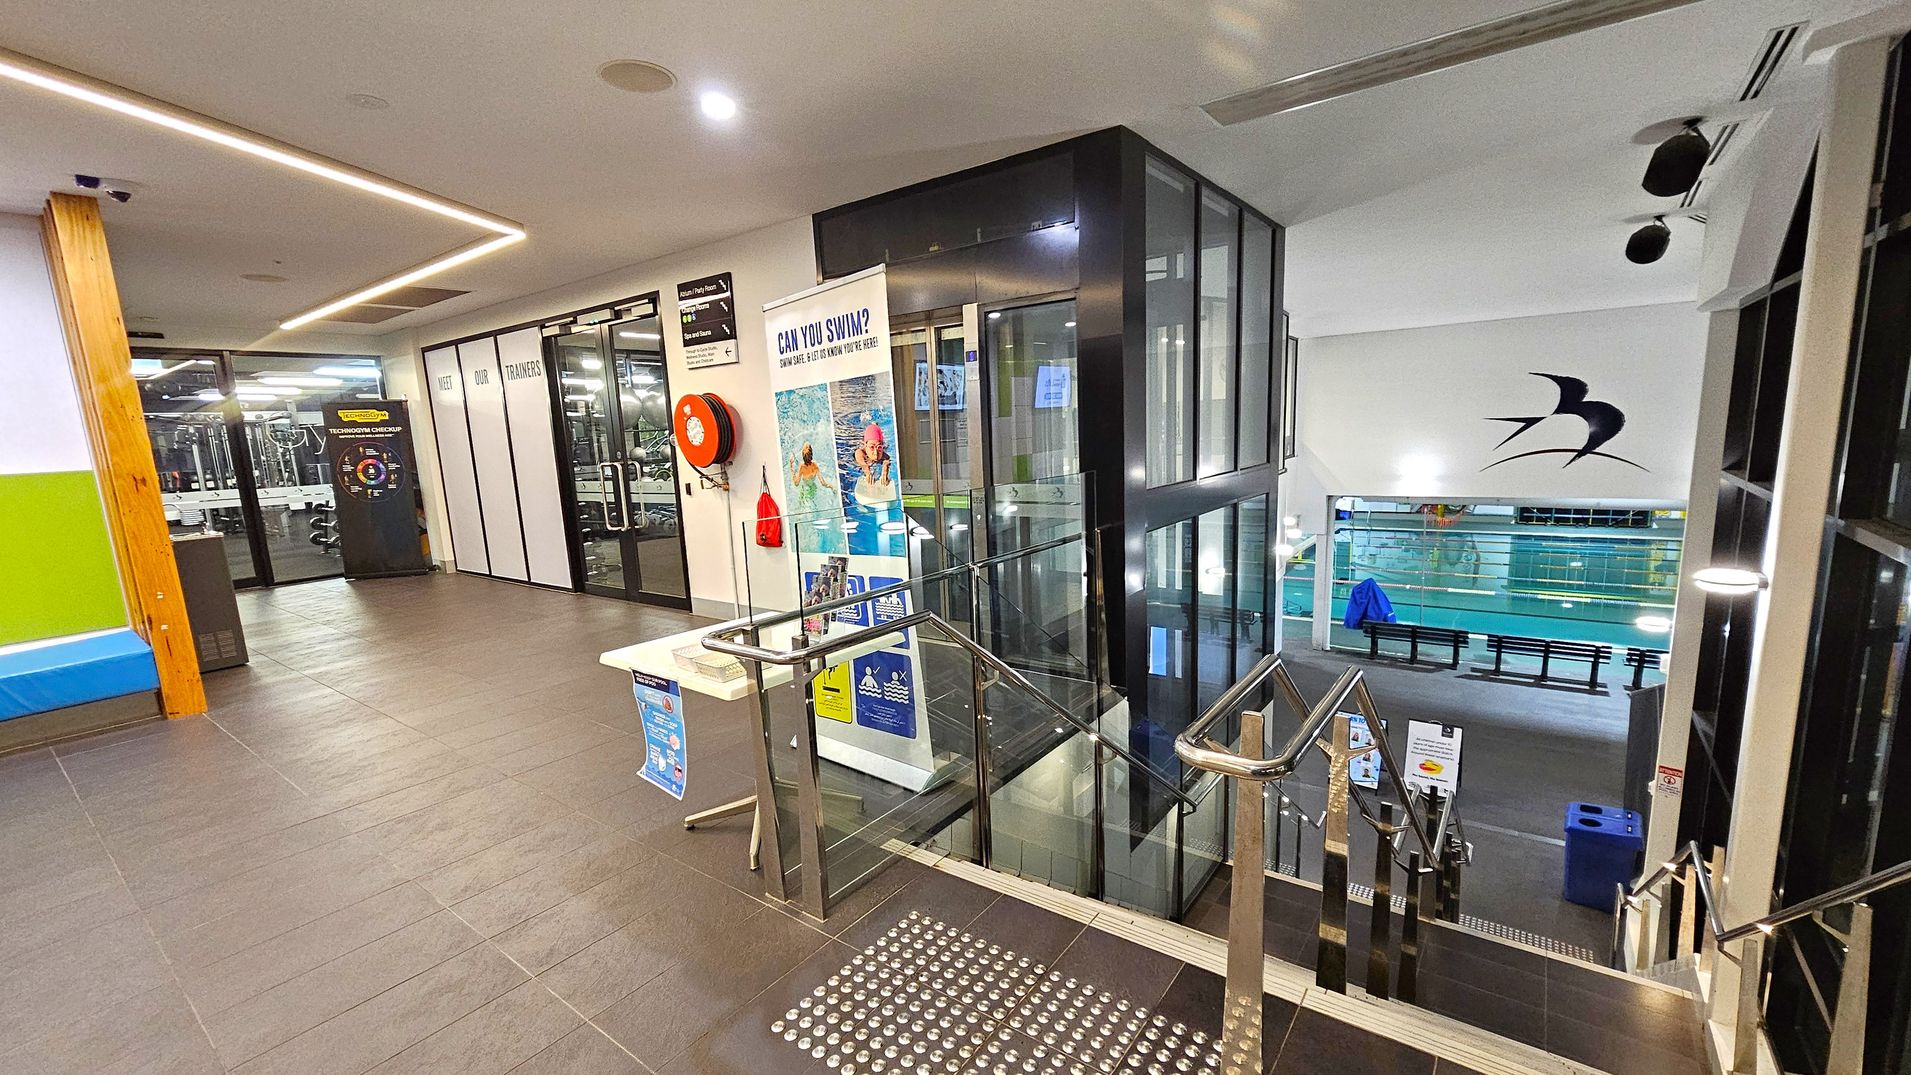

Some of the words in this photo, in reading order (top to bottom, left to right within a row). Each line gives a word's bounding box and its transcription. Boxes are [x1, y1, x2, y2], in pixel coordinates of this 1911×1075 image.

[680, 290, 692, 298] Atrium
[695, 287, 704, 295] Party
[704, 284, 717, 292] Room
[681, 305, 696, 314] Change
[699, 329, 712, 337] Sauna
[777, 328, 799, 355] CAN
[800, 321, 823, 349] YOU
[826, 308, 870, 343] SWIM?
[779, 357, 793, 369] SWIM
[806, 352, 811, 363] &
[811, 350, 820, 362] LET
[819, 349, 827, 360] US
[827, 346, 843, 358] KNOW
[843, 341, 863, 355] YOU'RE
[863, 336, 879, 351] HERE!
[474, 369, 489, 386] OUR
[505, 360, 542, 381] TRAINERS
[438, 375, 453, 391] MEET
